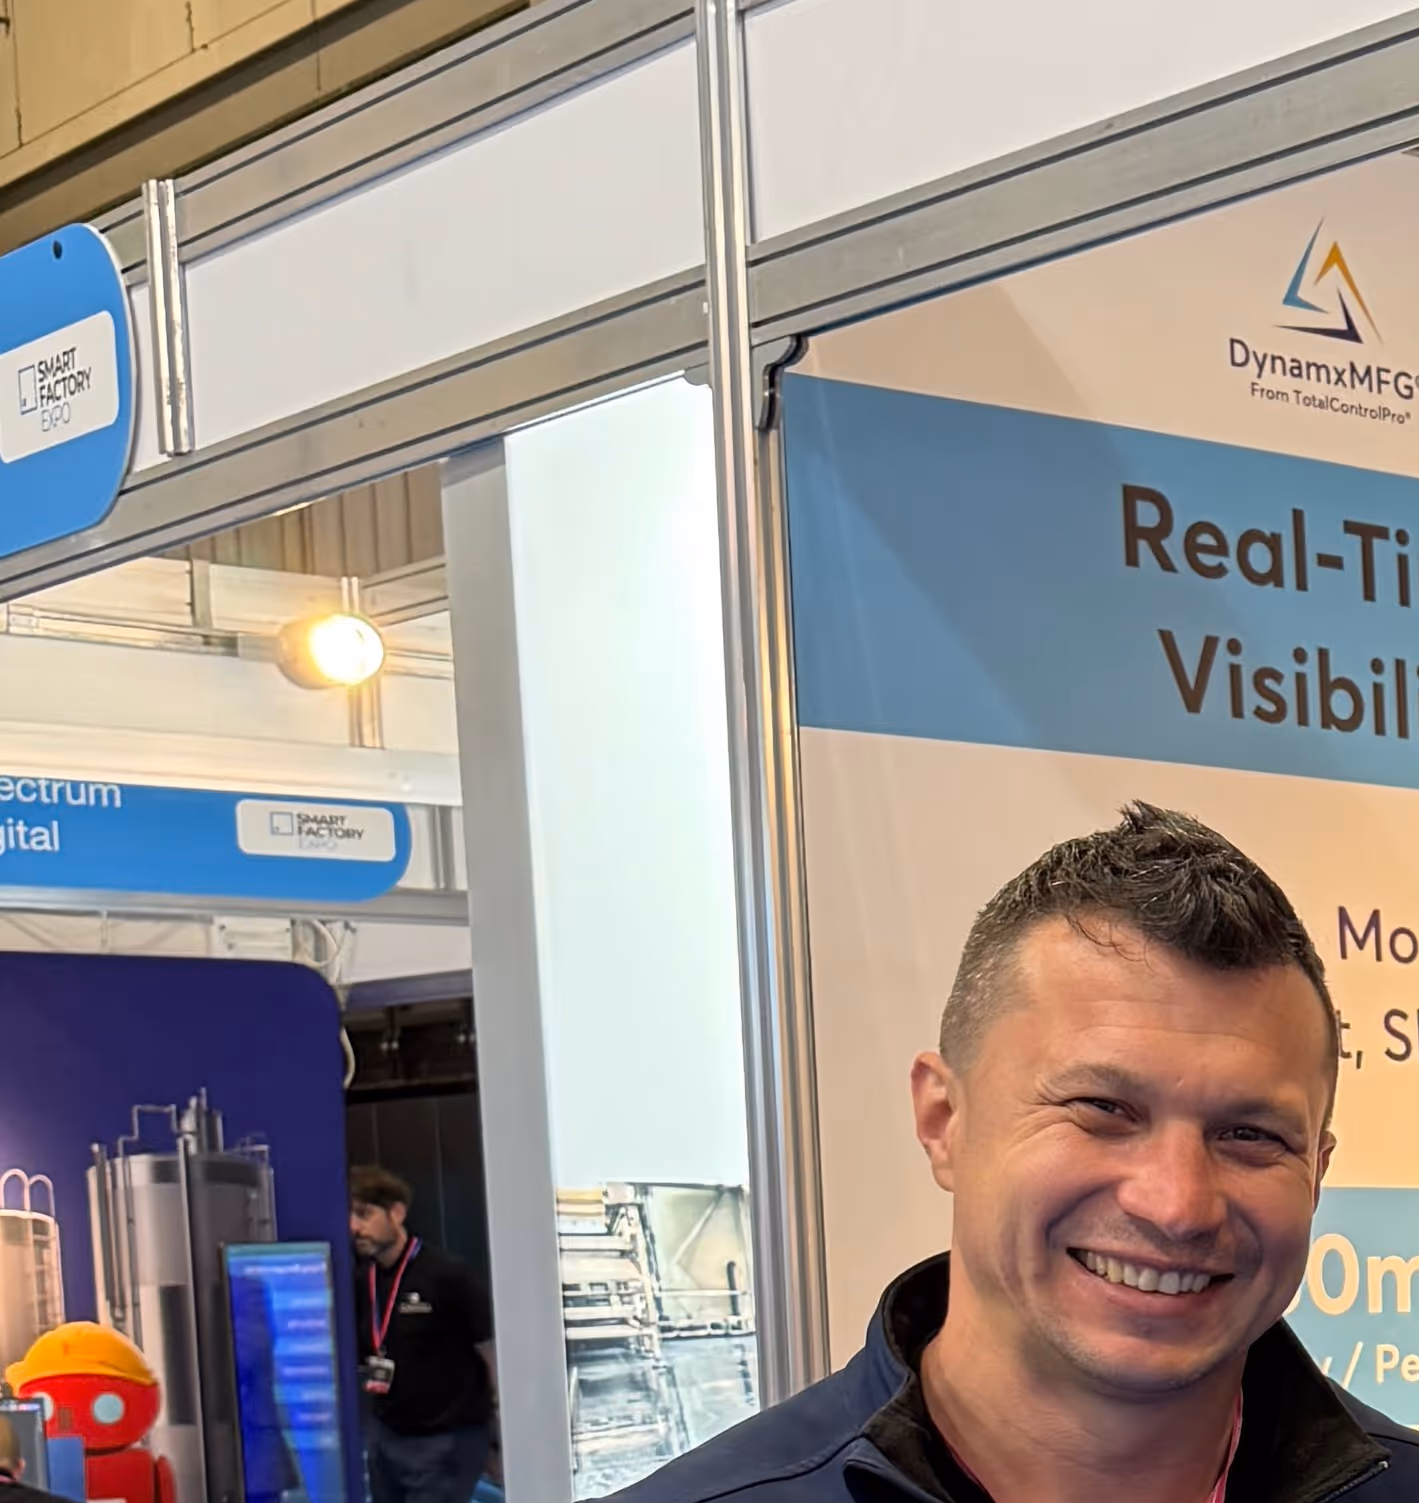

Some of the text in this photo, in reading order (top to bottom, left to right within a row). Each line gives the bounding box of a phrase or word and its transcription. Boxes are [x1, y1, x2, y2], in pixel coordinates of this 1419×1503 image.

[37, 346, 77, 382] SMART
[39, 366, 91, 407] FACTORY
[1250, 382, 1289, 404] From
[297, 825, 365, 841] FACTORY
[1336, 1010, 1364, 1070] t,
